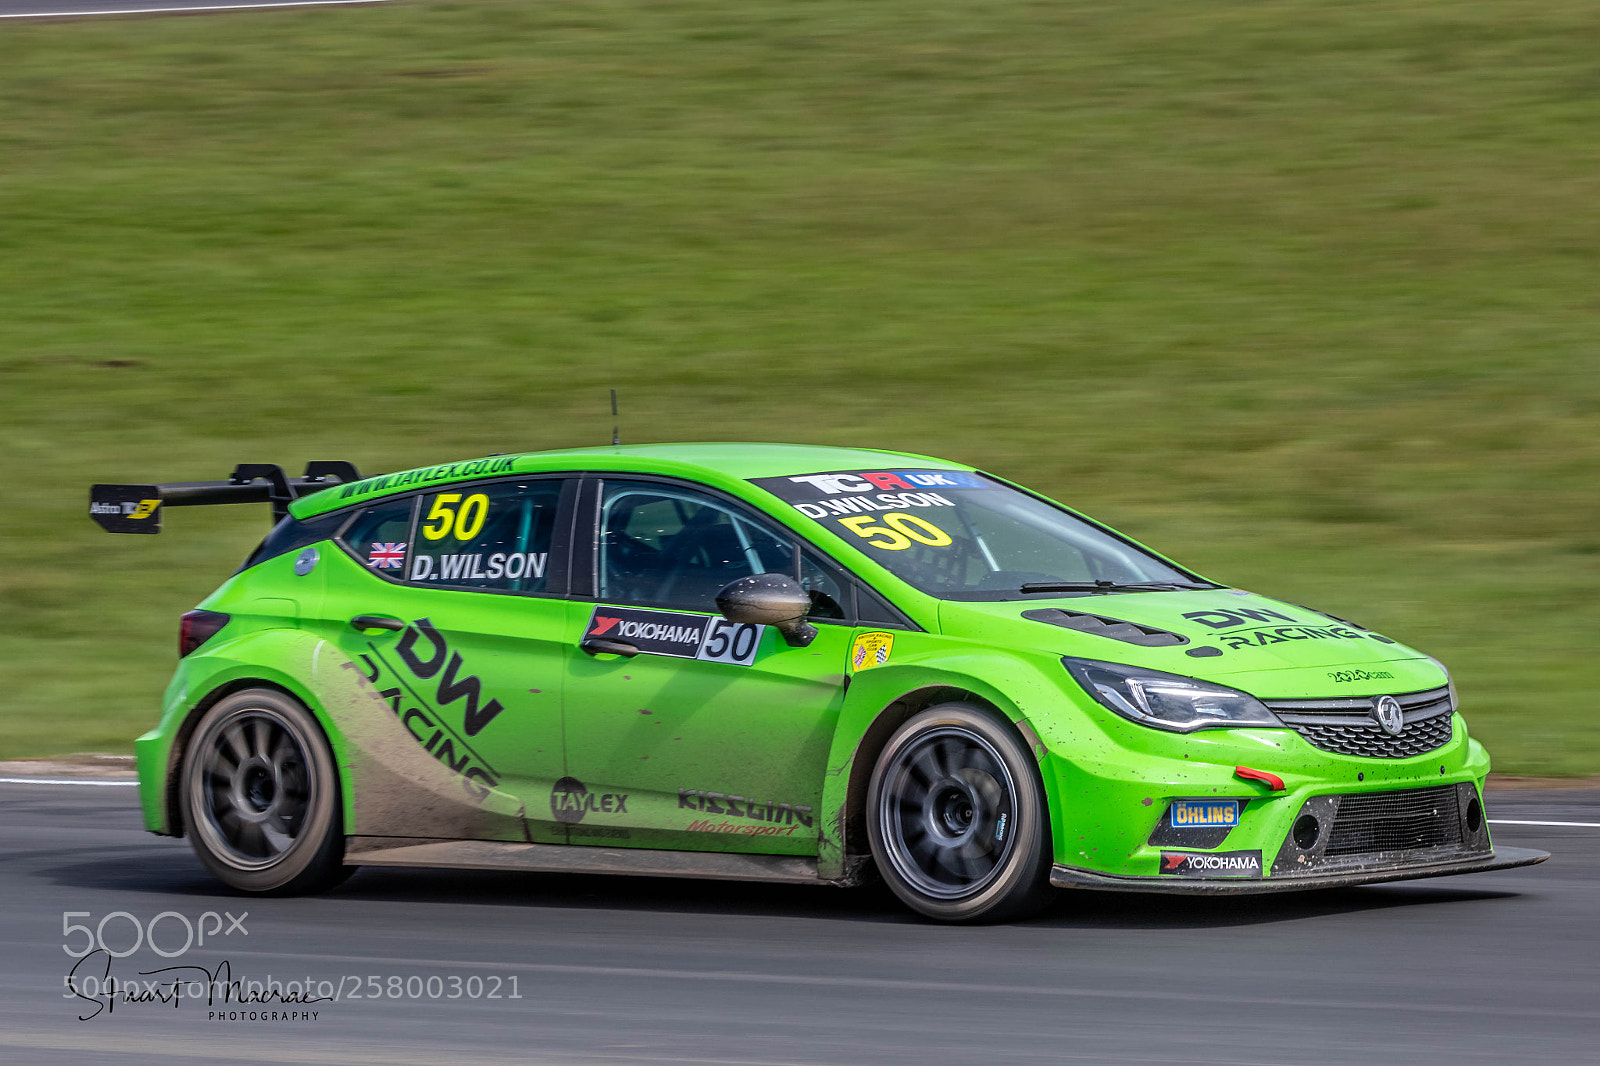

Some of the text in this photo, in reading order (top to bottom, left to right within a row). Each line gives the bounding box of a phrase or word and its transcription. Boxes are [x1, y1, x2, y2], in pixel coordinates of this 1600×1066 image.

[789, 473, 958, 494] TCR UK
[423, 493, 490, 541] 50
[792, 492, 956, 519] D.WILSON
[837, 512, 953, 551] 50
[411, 552, 548, 581] D.WILSON
[1181, 608, 1298, 629] DW
[617, 620, 700, 645] YOKOHAMA
[706, 619, 758, 662] 50
[1219, 627, 1366, 650] RACING
[395, 617, 505, 737] DW
[553, 791, 629, 814] TAYLEX
[1176, 803, 1235, 824] ÖHLINS
[684, 818, 800, 837] Motorsport
[1187, 857, 1259, 869] YOKOHAMA
